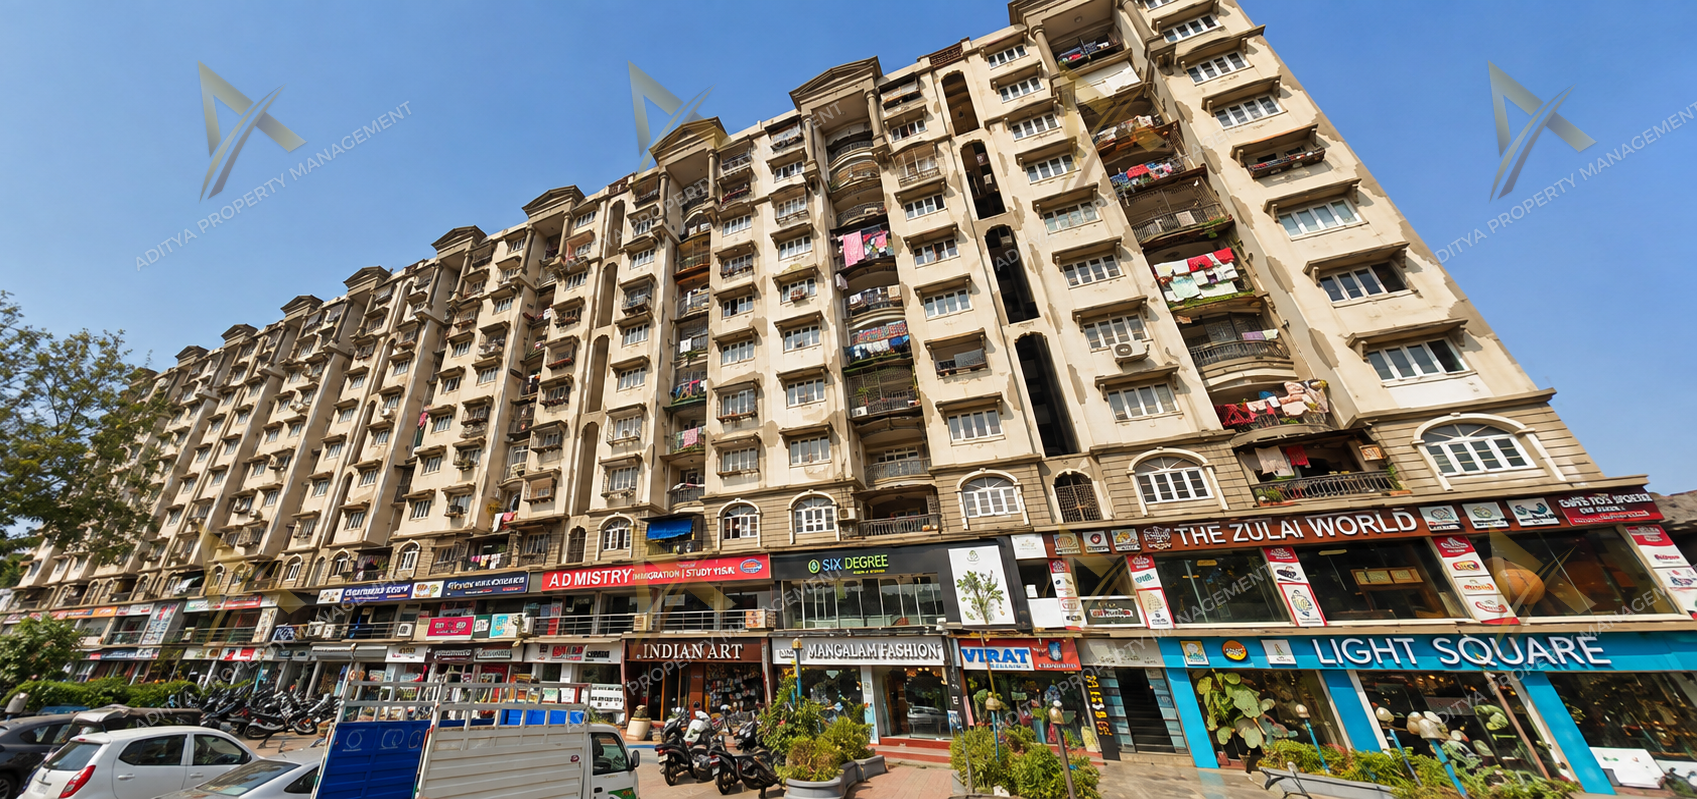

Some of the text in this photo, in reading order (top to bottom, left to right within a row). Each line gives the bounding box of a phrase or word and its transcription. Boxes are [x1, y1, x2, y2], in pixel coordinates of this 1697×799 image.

[1174, 524, 1226, 545] THE
[1229, 519, 1304, 542] ZULAI
[1306, 511, 1418, 538] WORLD
[822, 554, 889, 572] SIX DEGREE
[549, 568, 632, 587] A D MISTRY
[685, 567, 712, 578] STUDY
[643, 643, 743, 659] INDIAN ART
[808, 643, 877, 659] MANGALAM
[880, 642, 938, 659] FASHION
[961, 648, 1029, 664] VIRAT
[1312, 636, 1612, 666] LIGHT SQUARE
